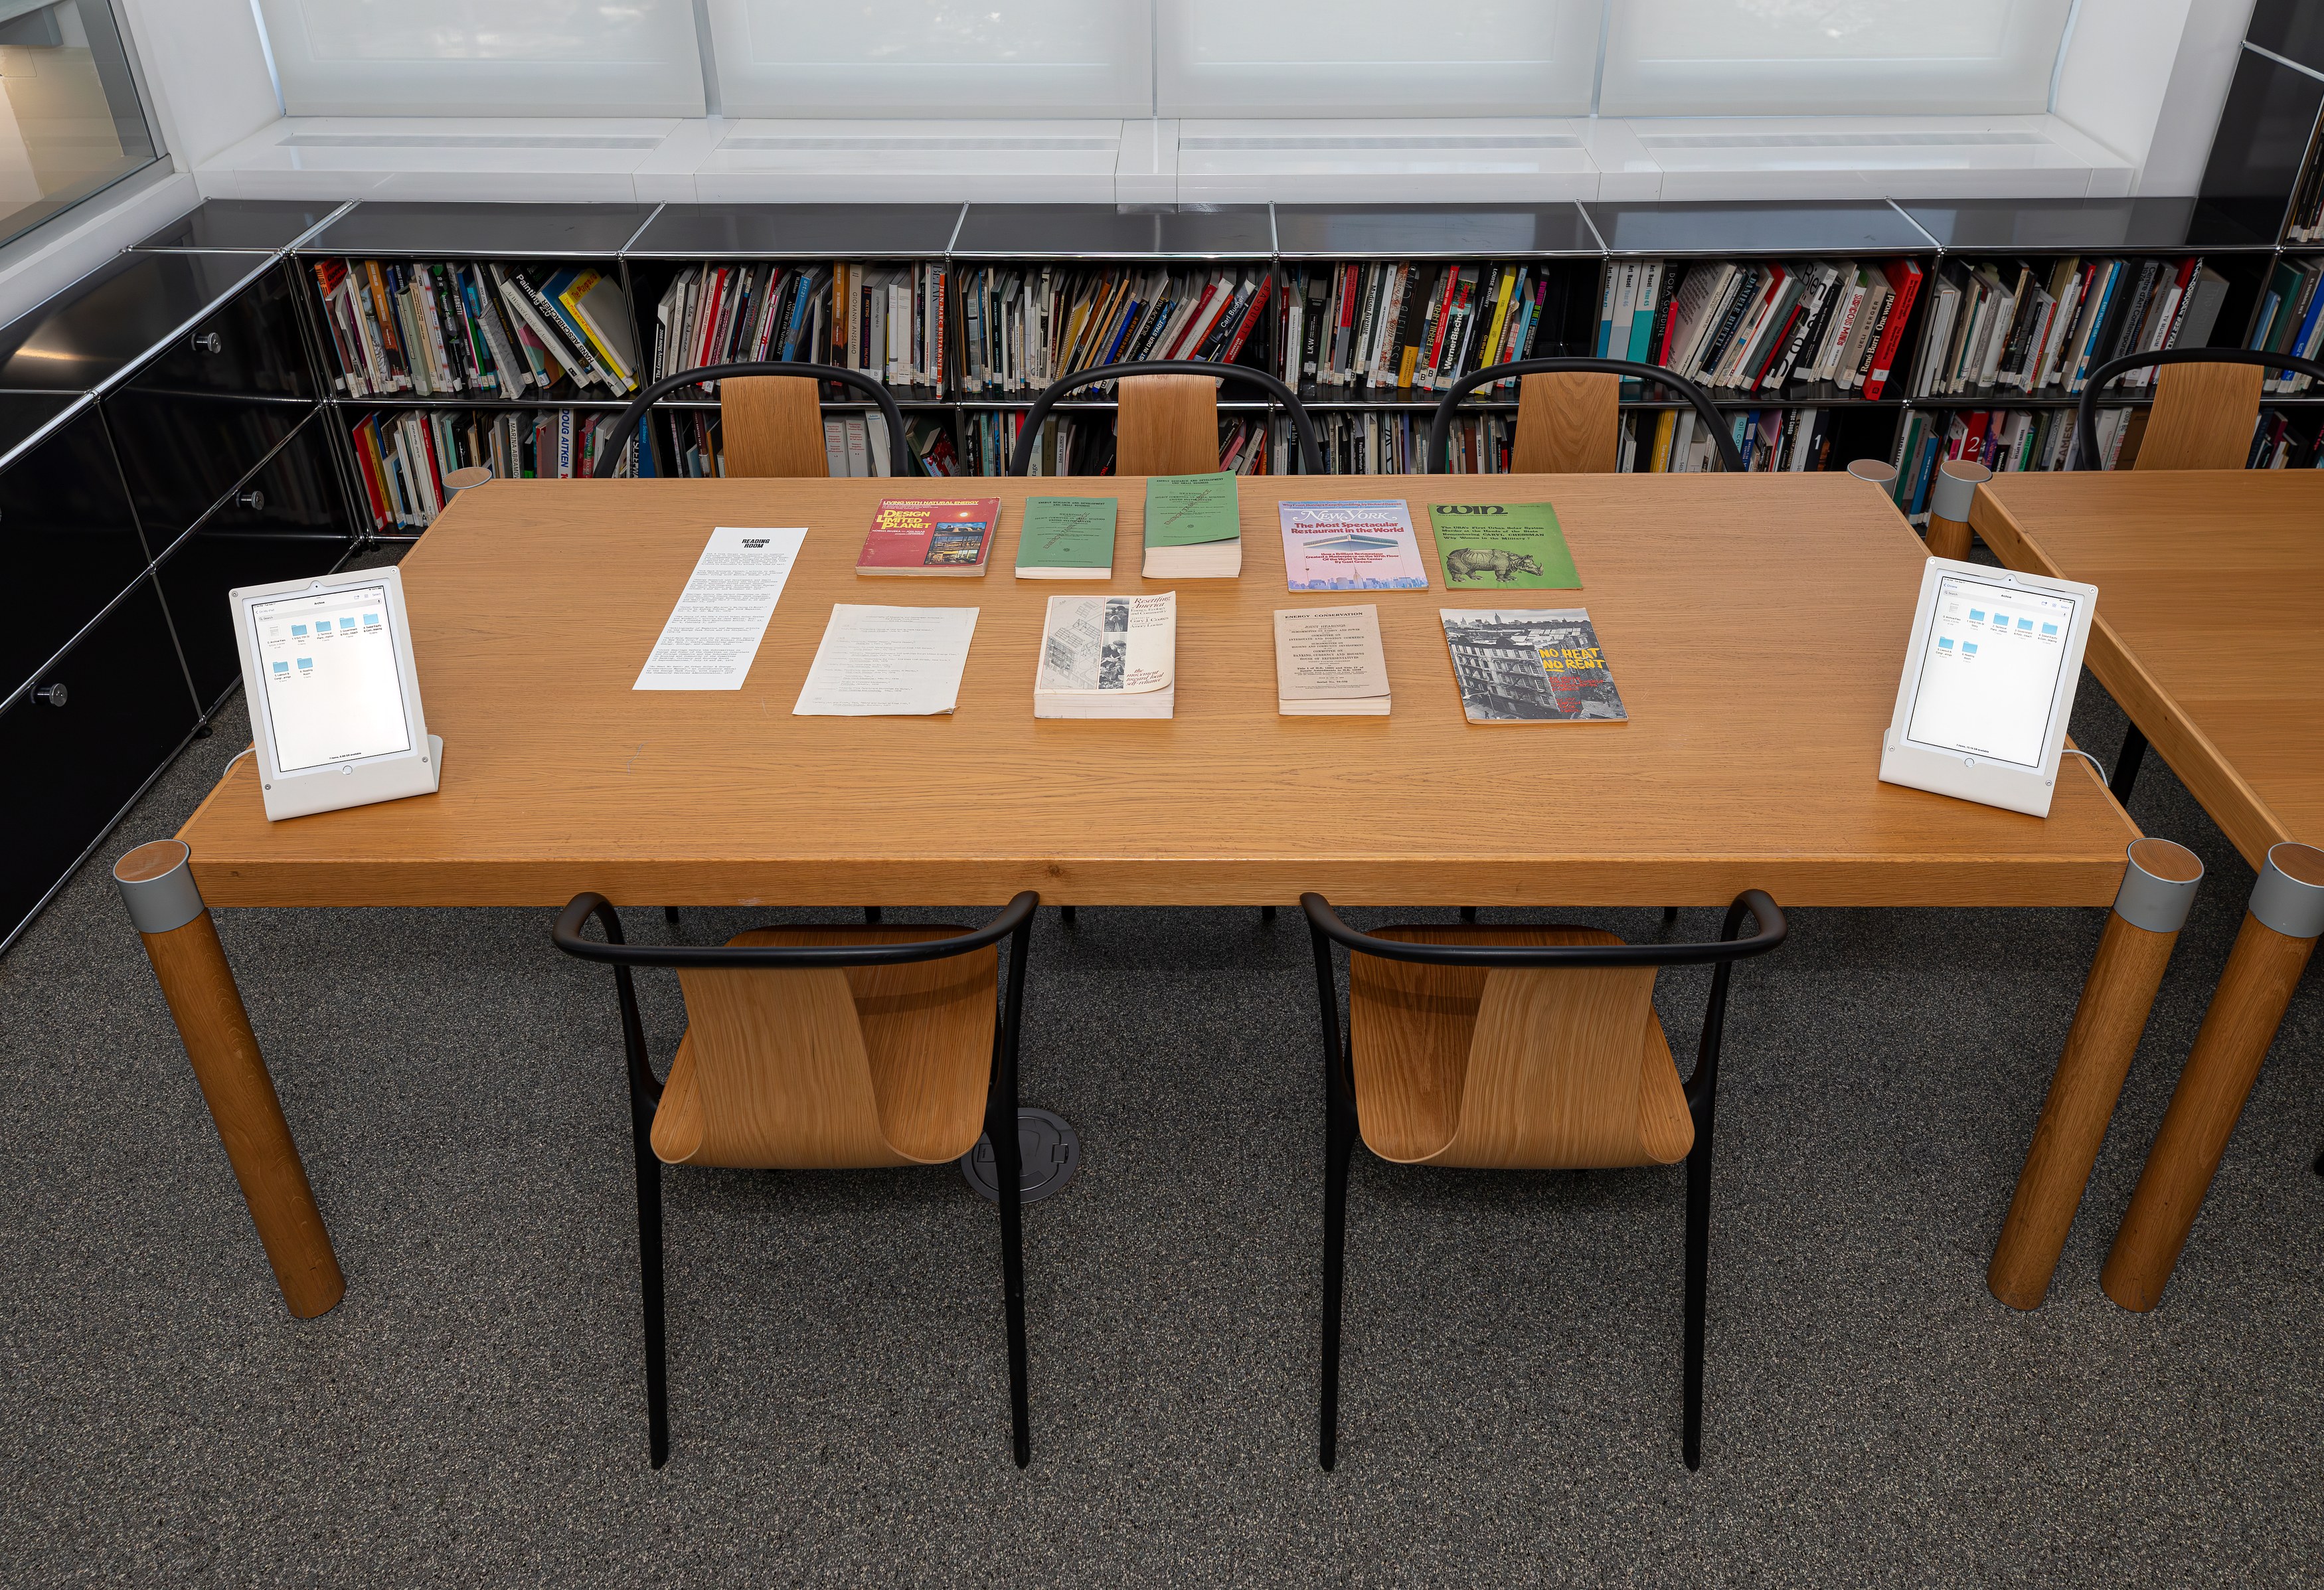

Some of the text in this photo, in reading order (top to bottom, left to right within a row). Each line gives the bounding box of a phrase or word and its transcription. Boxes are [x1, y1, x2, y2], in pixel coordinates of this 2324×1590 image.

[453, 295, 463, 315] AGNETTI
[516, 274, 551, 317] Painting 2.0
[571, 291, 581, 300] The
[1484, 268, 1498, 308] LOUISE BONNET
[1657, 272, 1675, 337] DORA GORDINE
[570, 304, 585, 325] Playground
[584, 323, 594, 337] Project
[1141, 299, 1163, 336] PALACES FOR
[1220, 296, 1244, 327] Carl Bucher
[1243, 286, 1270, 336] BASQUIAT
[1363, 285, 1376, 335] Madison Avenue
[1426, 304, 1442, 348] BRAILLARD
[1716, 276, 1757, 347] DANIELE BUETTI
[1844, 294, 1863, 327] SUSPICIOUS
[1858, 300, 1879, 349] UELI BERGER
[2118, 266, 2156, 359] Centre d'Art Contemporain
[540, 331, 556, 352] Animals
[542, 299, 594, 363] HANS AESCHBACHER
[1143, 320, 1164, 356] IN DER STADT
[2154, 323, 2165, 347] MUSEUM
[1860, 335, 1880, 373] René Burri
[1967, 436, 1980, 452] 2
[1538, 648, 1600, 660] NO HEAT
[1542, 659, 1606, 669] NO RENT
[1126, 678, 1162, 687] self-reliance
